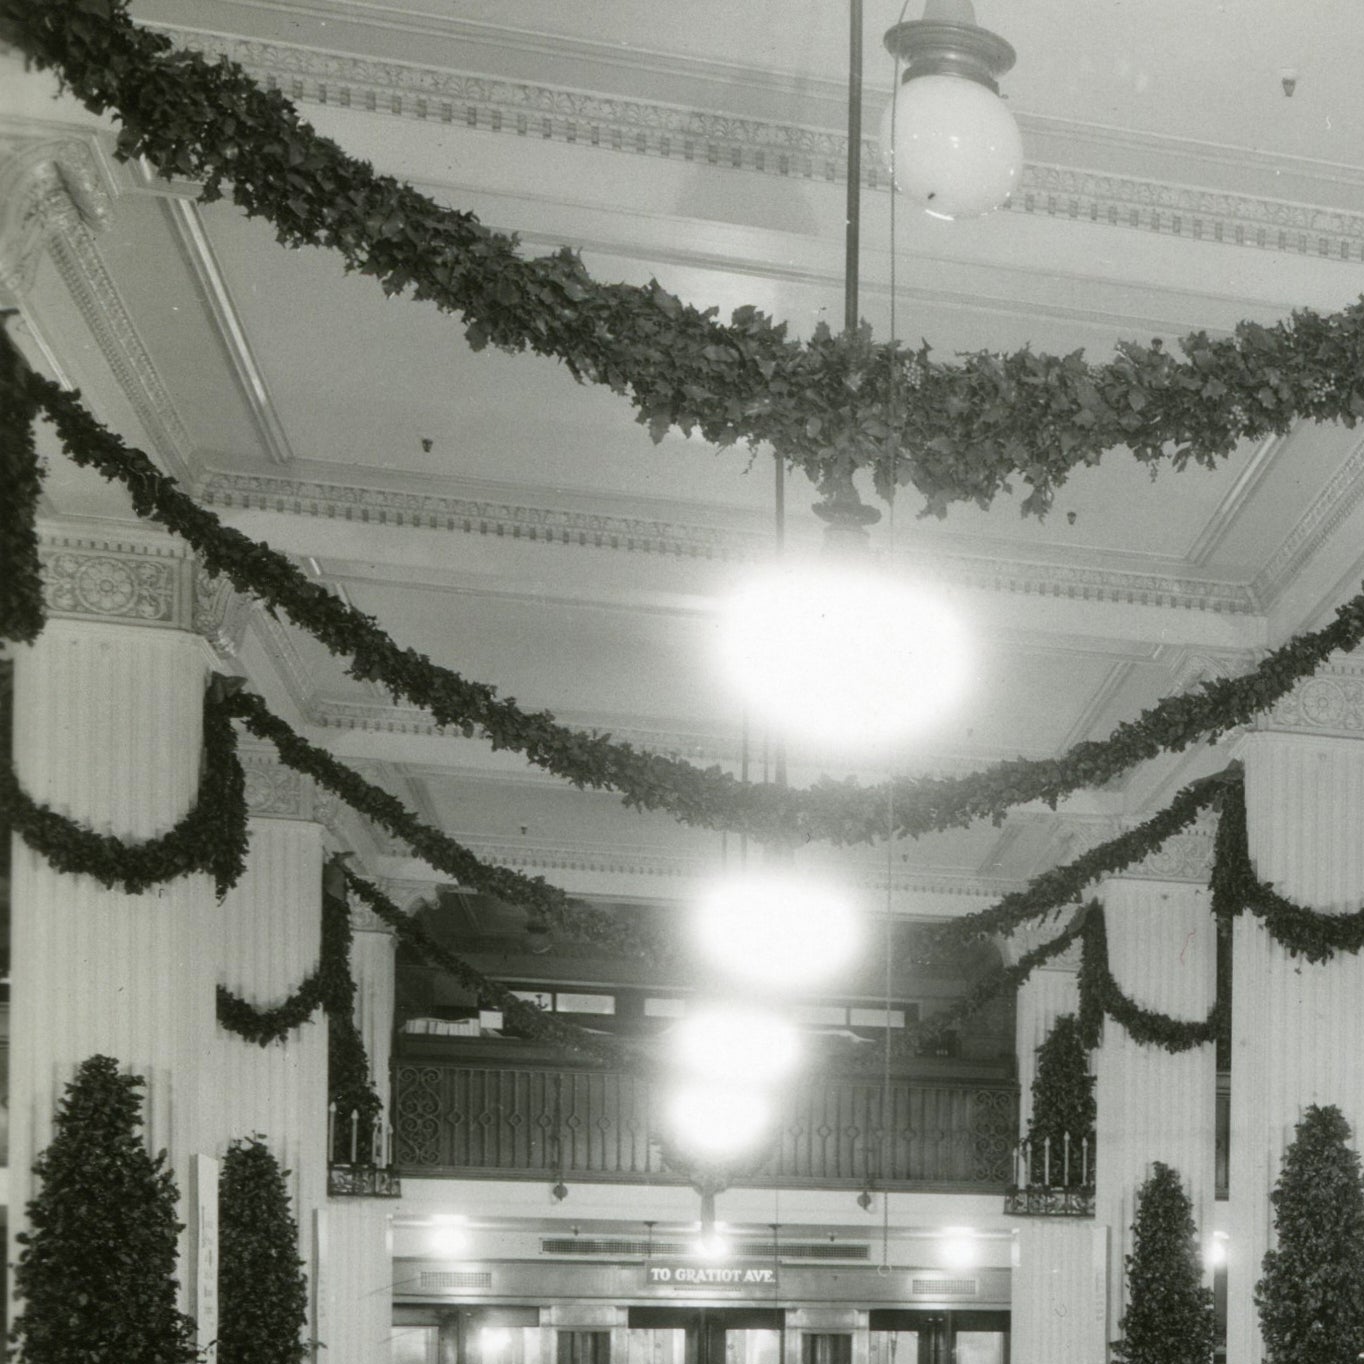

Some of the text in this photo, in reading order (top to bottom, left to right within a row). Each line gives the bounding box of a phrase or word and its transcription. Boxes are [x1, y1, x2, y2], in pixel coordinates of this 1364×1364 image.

[650, 1267, 776, 1283] TO GRATIOT AVE.
